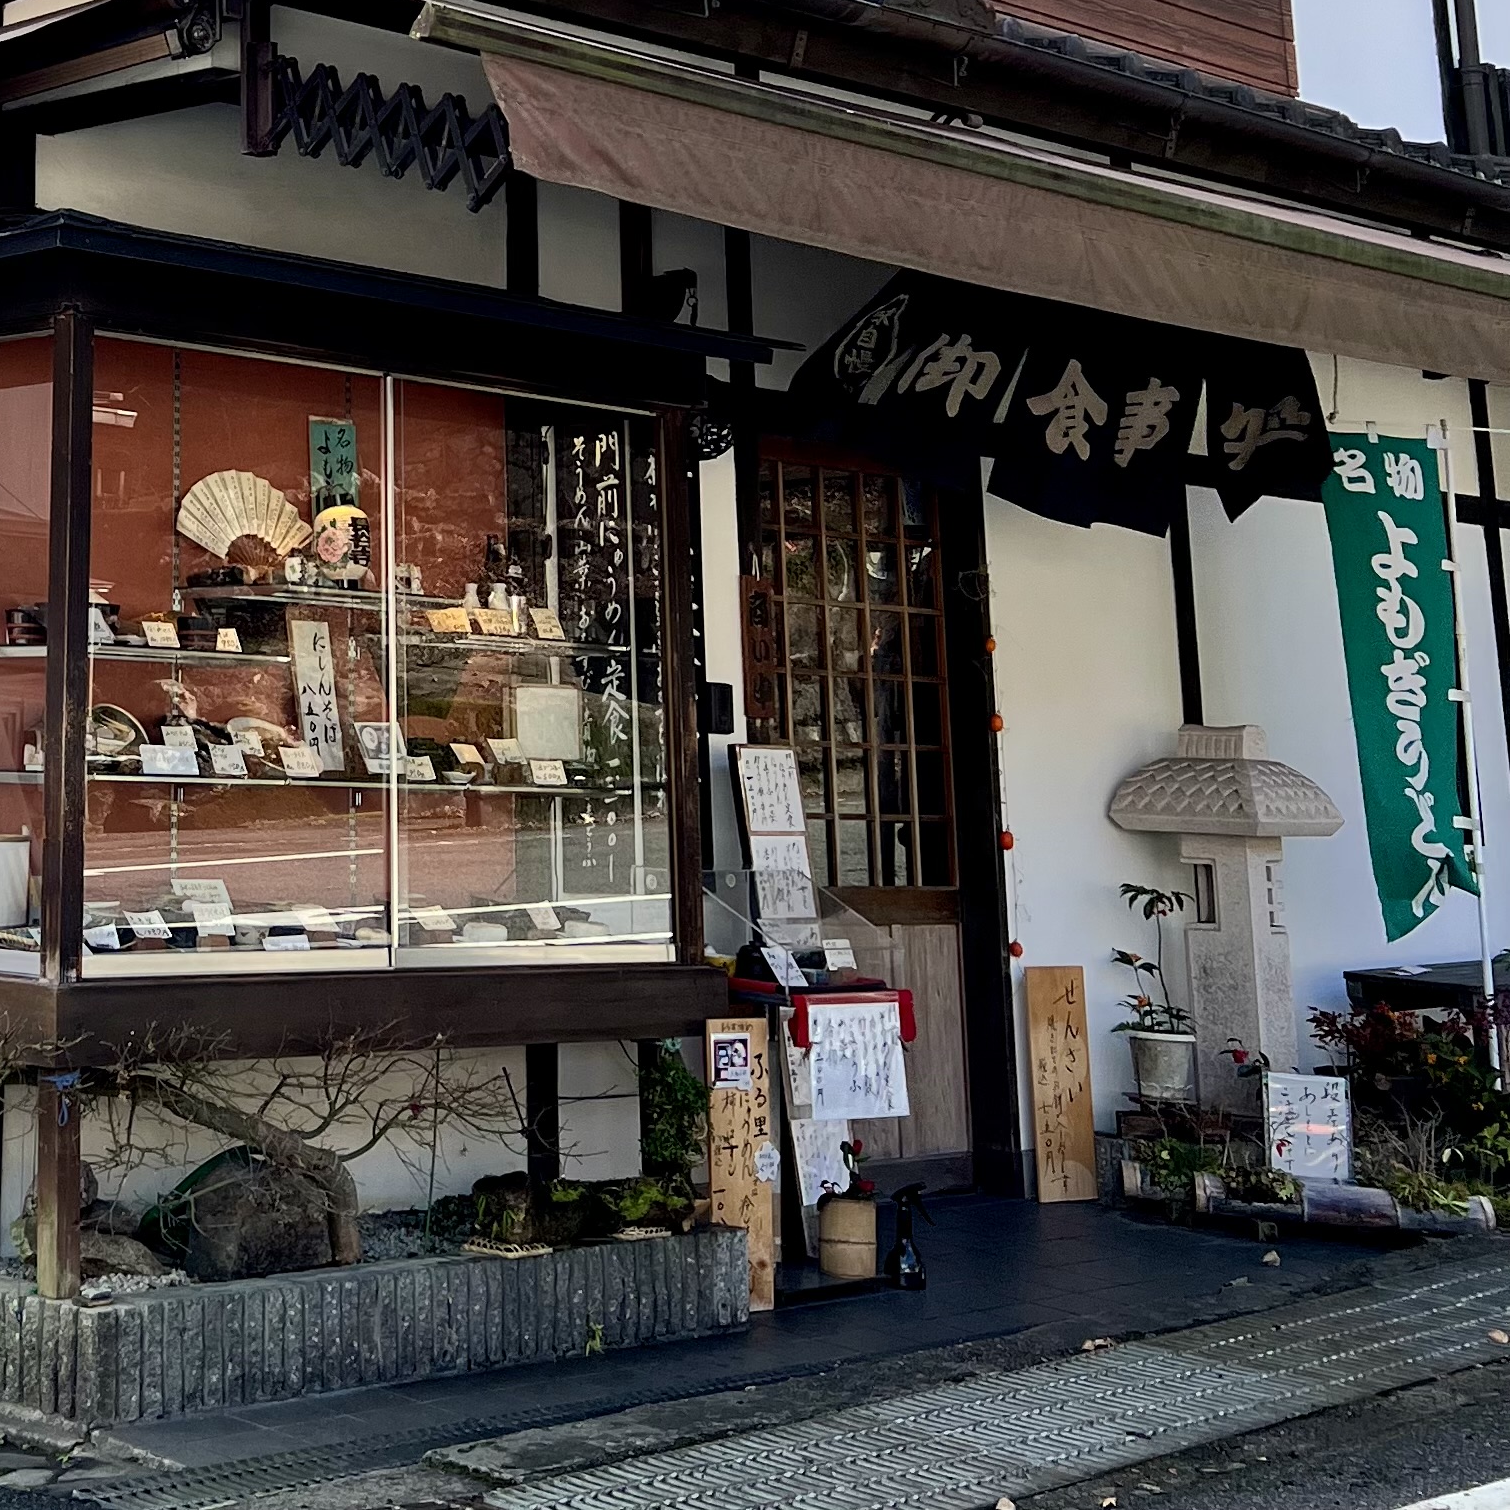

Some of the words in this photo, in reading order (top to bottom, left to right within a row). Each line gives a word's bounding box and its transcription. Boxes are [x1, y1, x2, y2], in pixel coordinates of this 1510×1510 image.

[897, 332, 1313, 472] 御食事処
[335, 428, 354, 476] 名物
[1333, 446, 1425, 501] 名物
[312, 632, 337, 744] にしんそば
[1052, 977, 1083, 1103] ぜんざい
[750, 1052, 769, 1138] ふる里
